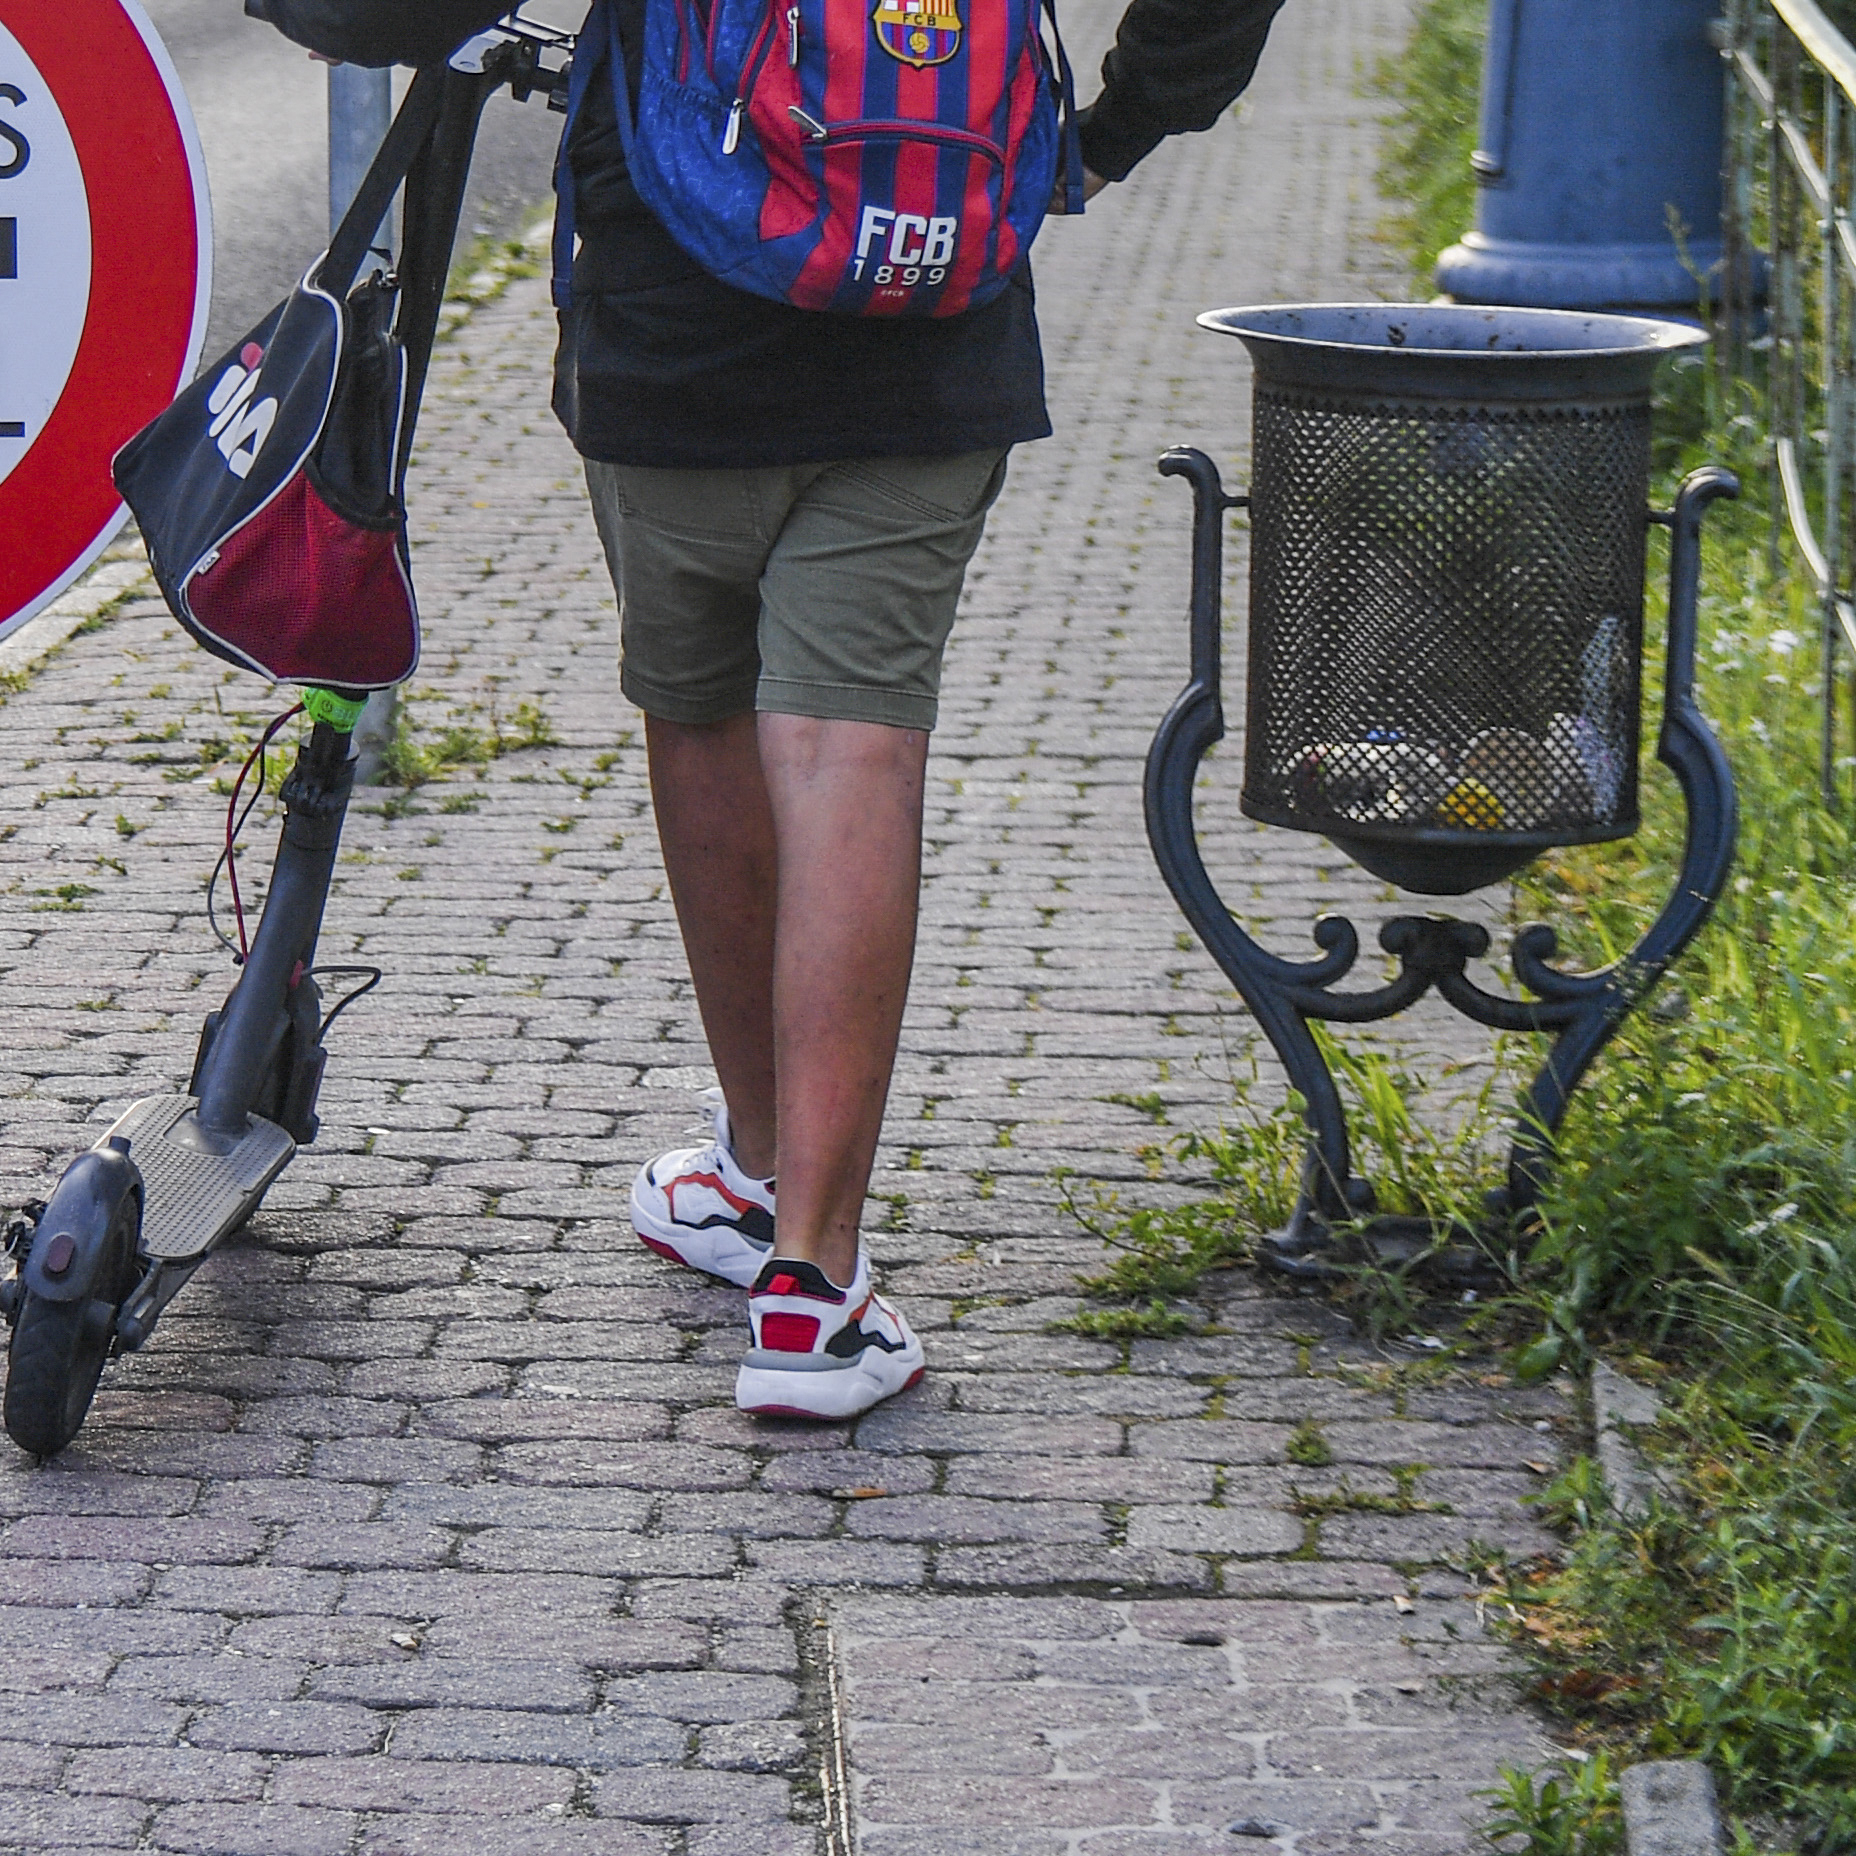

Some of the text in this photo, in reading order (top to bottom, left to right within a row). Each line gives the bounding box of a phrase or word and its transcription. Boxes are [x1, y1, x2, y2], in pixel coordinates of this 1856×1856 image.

[902, 13, 937, 26] FCB
[856, 205, 958, 266] FCB
[854, 259, 946, 286] 1899
